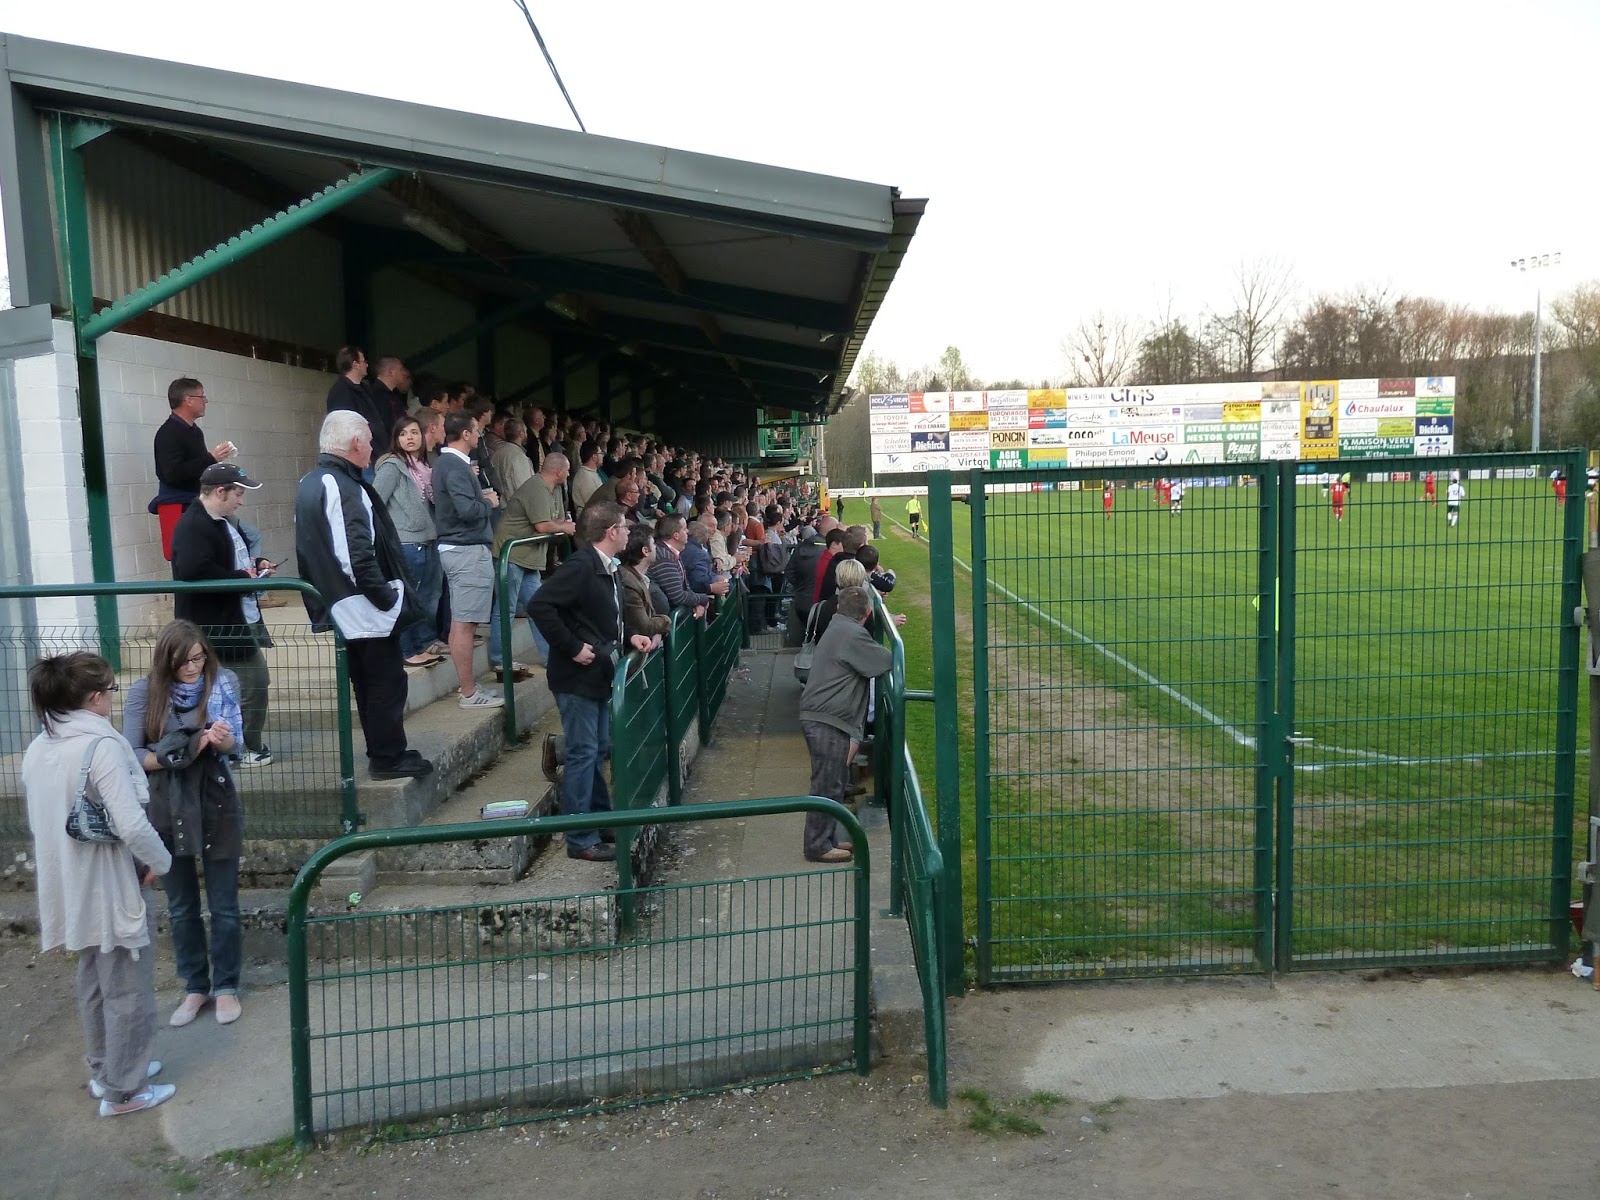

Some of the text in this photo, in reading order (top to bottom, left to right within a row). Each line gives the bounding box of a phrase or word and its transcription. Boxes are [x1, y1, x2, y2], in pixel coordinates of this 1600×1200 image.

[1357, 404, 1404, 413] Chaufalux
[1229, 423, 1259, 432] ROYAL
[992, 432, 1026, 443] PONCIN
[1186, 432, 1258, 442] NESTOR OUTER
[1350, 438, 1387, 446] MAISON
[1388, 436, 1415, 445] VERTE
[1075, 449, 1107, 457] Philippe
[1227, 442, 1257, 455] PEARLE
[998, 450, 1020, 460] AGRI
[957, 458, 989, 467] Virton
